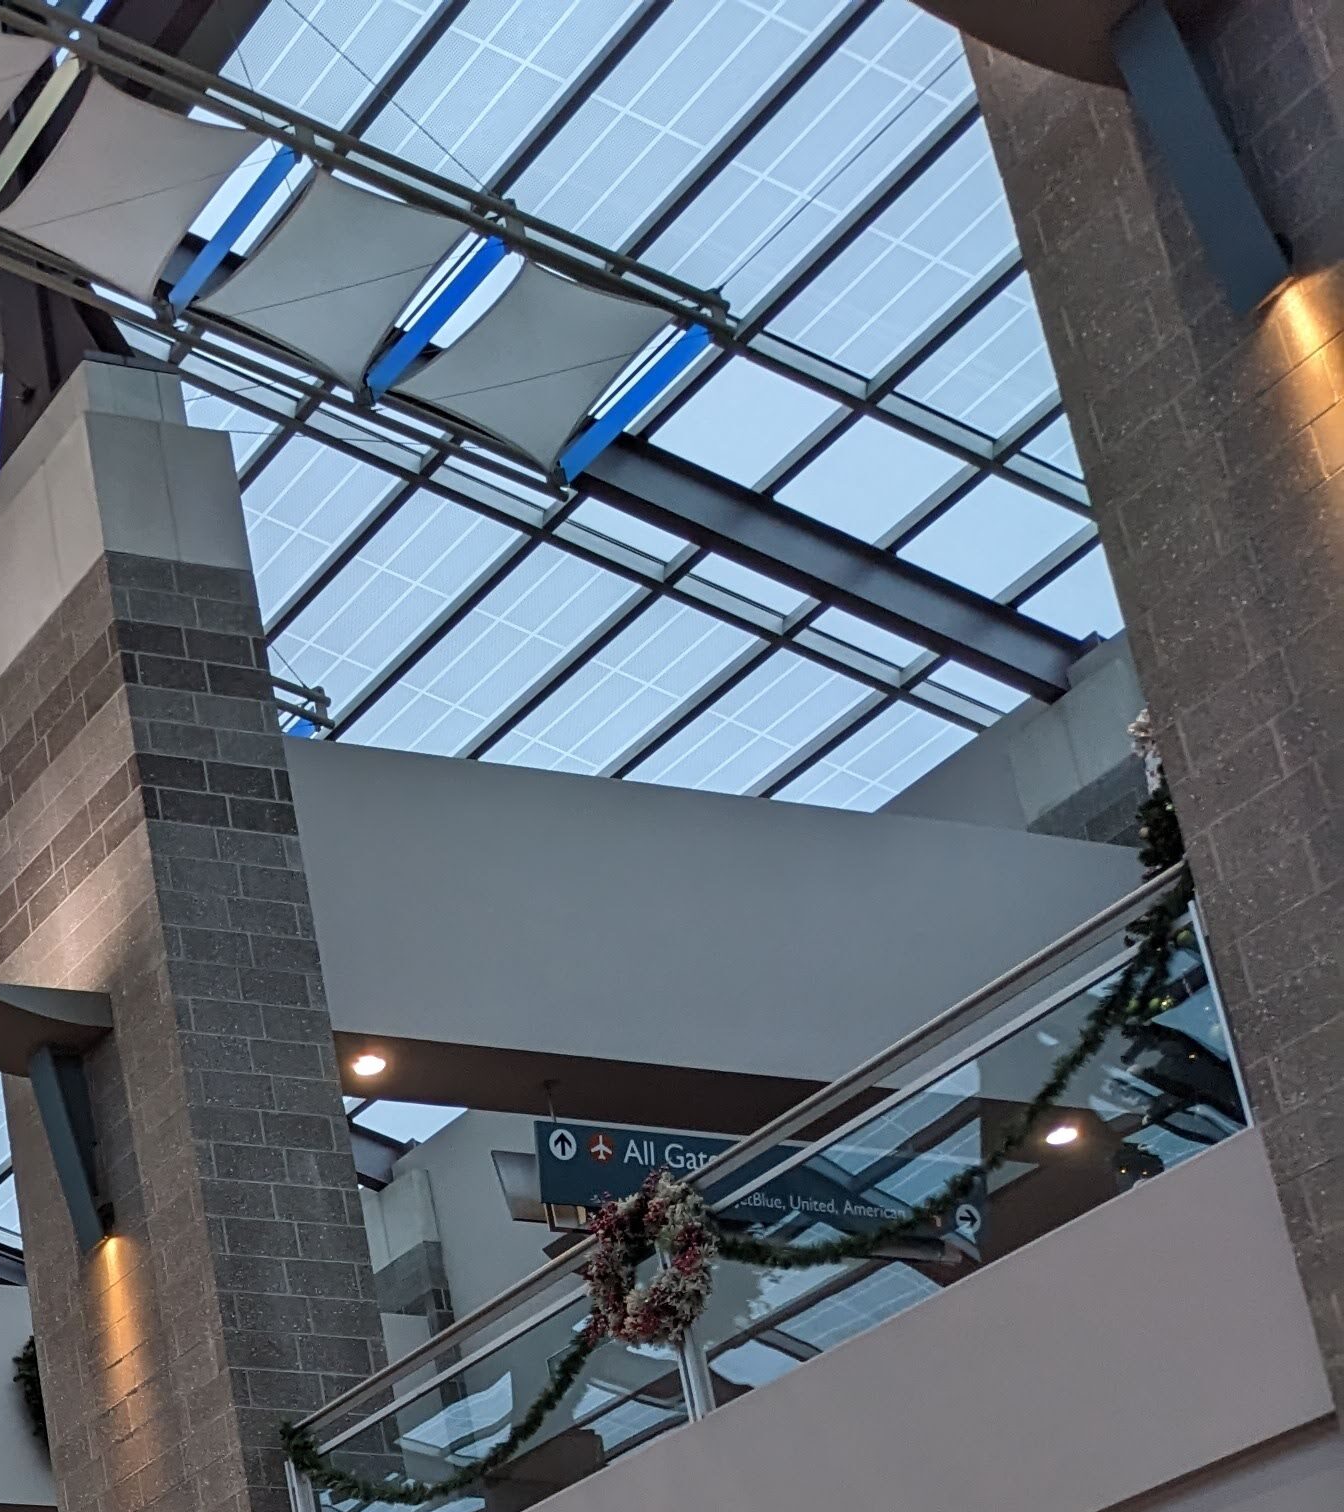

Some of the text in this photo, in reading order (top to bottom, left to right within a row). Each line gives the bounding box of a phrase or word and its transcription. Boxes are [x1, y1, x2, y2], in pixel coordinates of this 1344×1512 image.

[623, 1139, 655, 1166] All
[789, 1195, 839, 1214] United,
[843, 1201, 906, 1220] American
